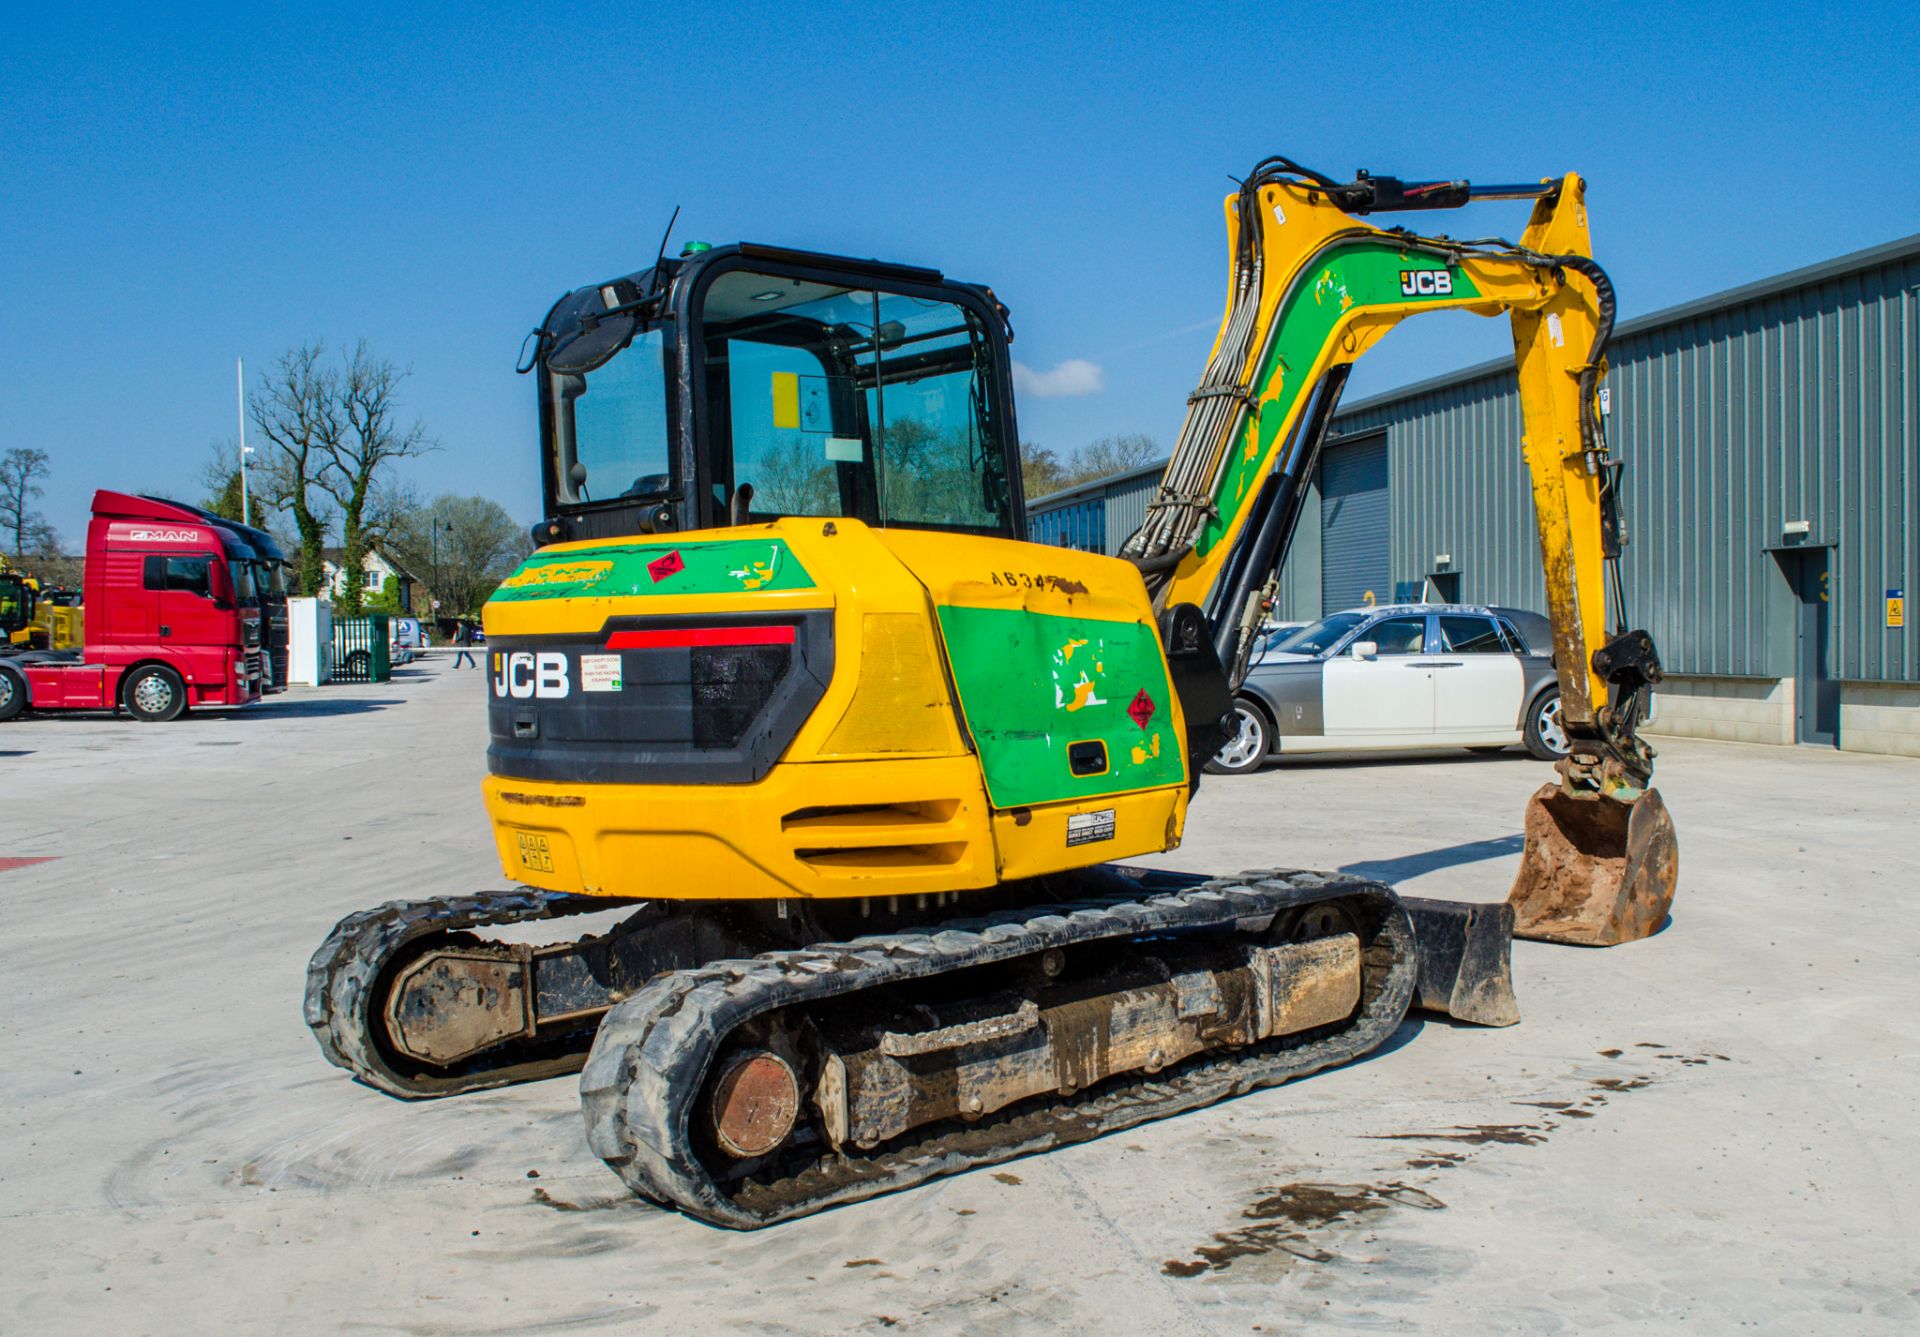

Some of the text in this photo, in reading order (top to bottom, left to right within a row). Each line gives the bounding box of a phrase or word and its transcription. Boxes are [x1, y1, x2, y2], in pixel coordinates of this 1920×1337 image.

[1401, 270, 1453, 295] JCB
[147, 530, 198, 541] MAN
[494, 652, 570, 699] JCB
